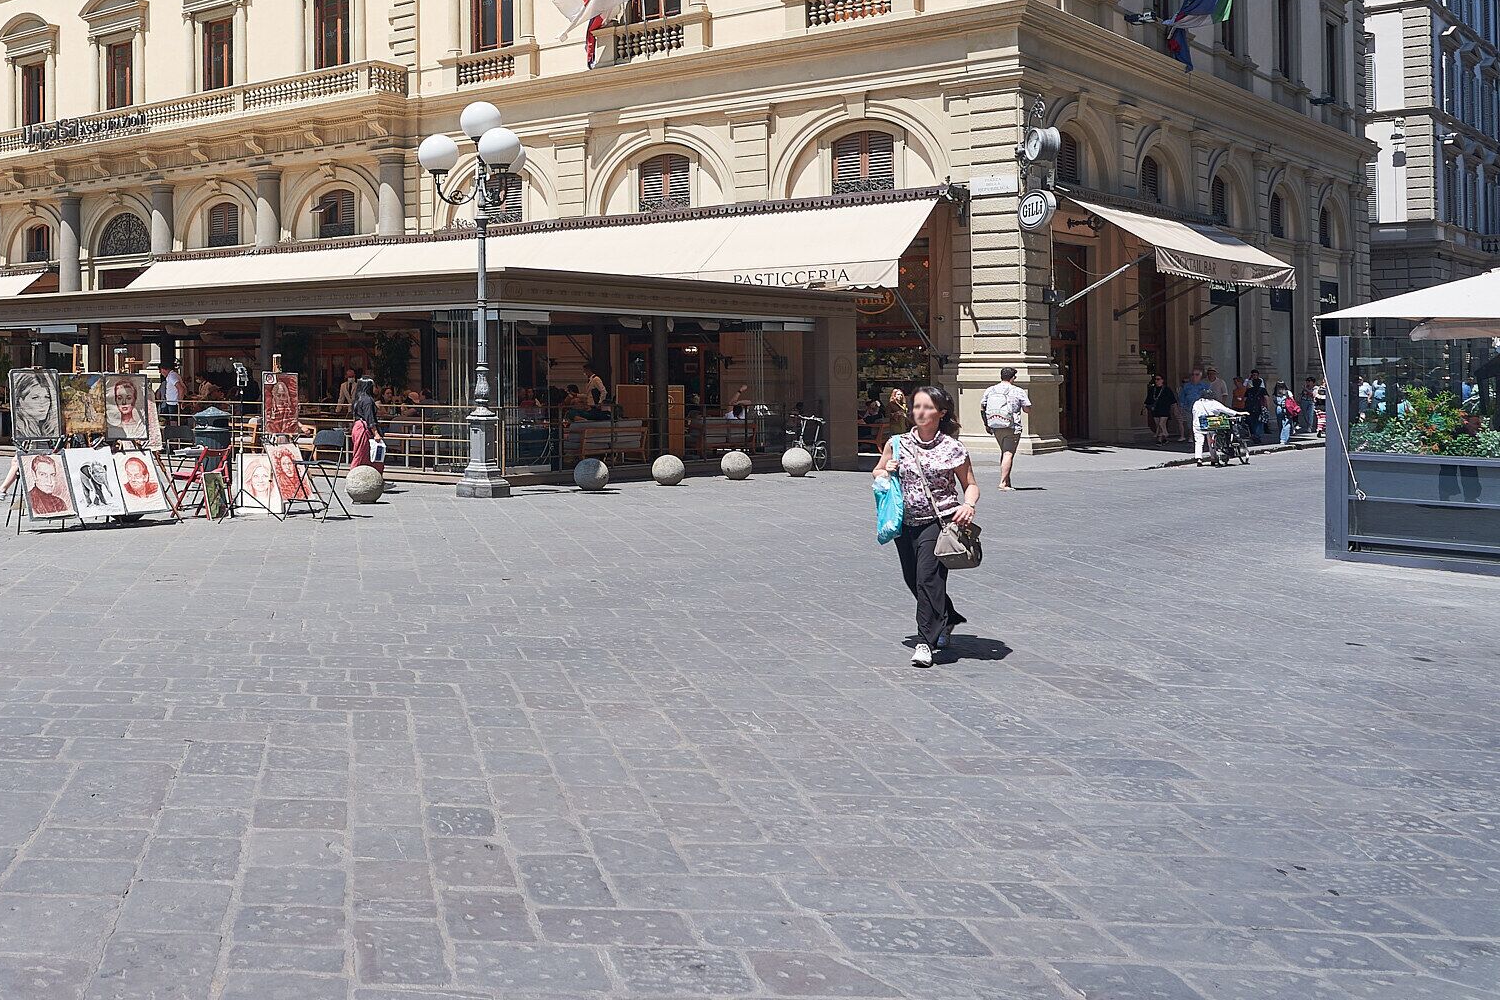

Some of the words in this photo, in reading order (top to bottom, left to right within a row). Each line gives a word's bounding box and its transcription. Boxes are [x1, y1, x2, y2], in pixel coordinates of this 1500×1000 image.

[1172, 254, 1203, 273] OCKTAIL
[1204, 260, 1217, 276] BAR
[733, 268, 851, 286] PASTICCERIA
